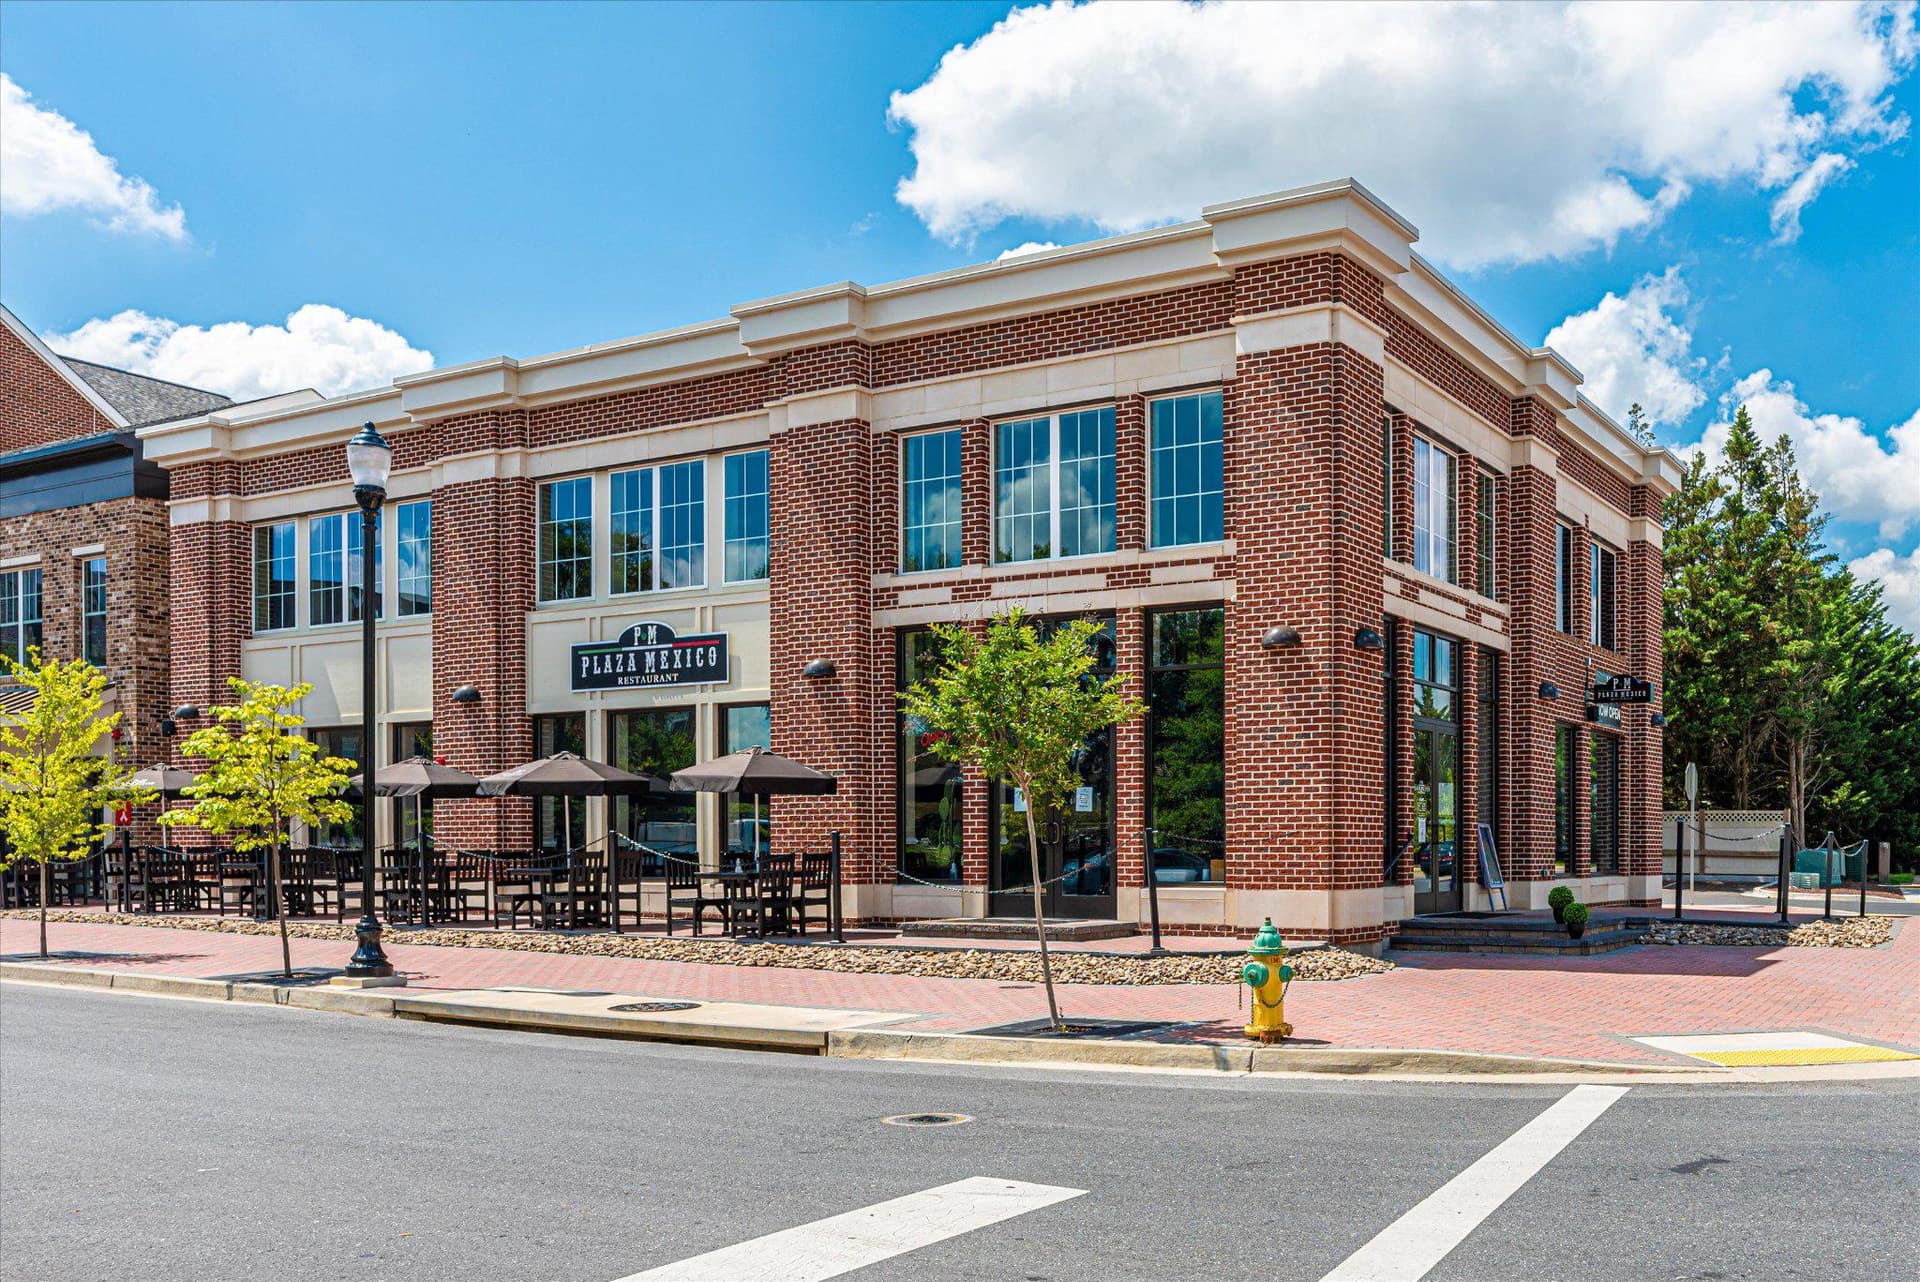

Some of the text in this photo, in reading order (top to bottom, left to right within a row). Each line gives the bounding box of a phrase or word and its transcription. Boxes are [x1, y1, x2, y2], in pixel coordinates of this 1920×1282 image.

[581, 646, 717, 678] PLAZA MEXICO
[618, 673, 679, 685] RESTAURANT
